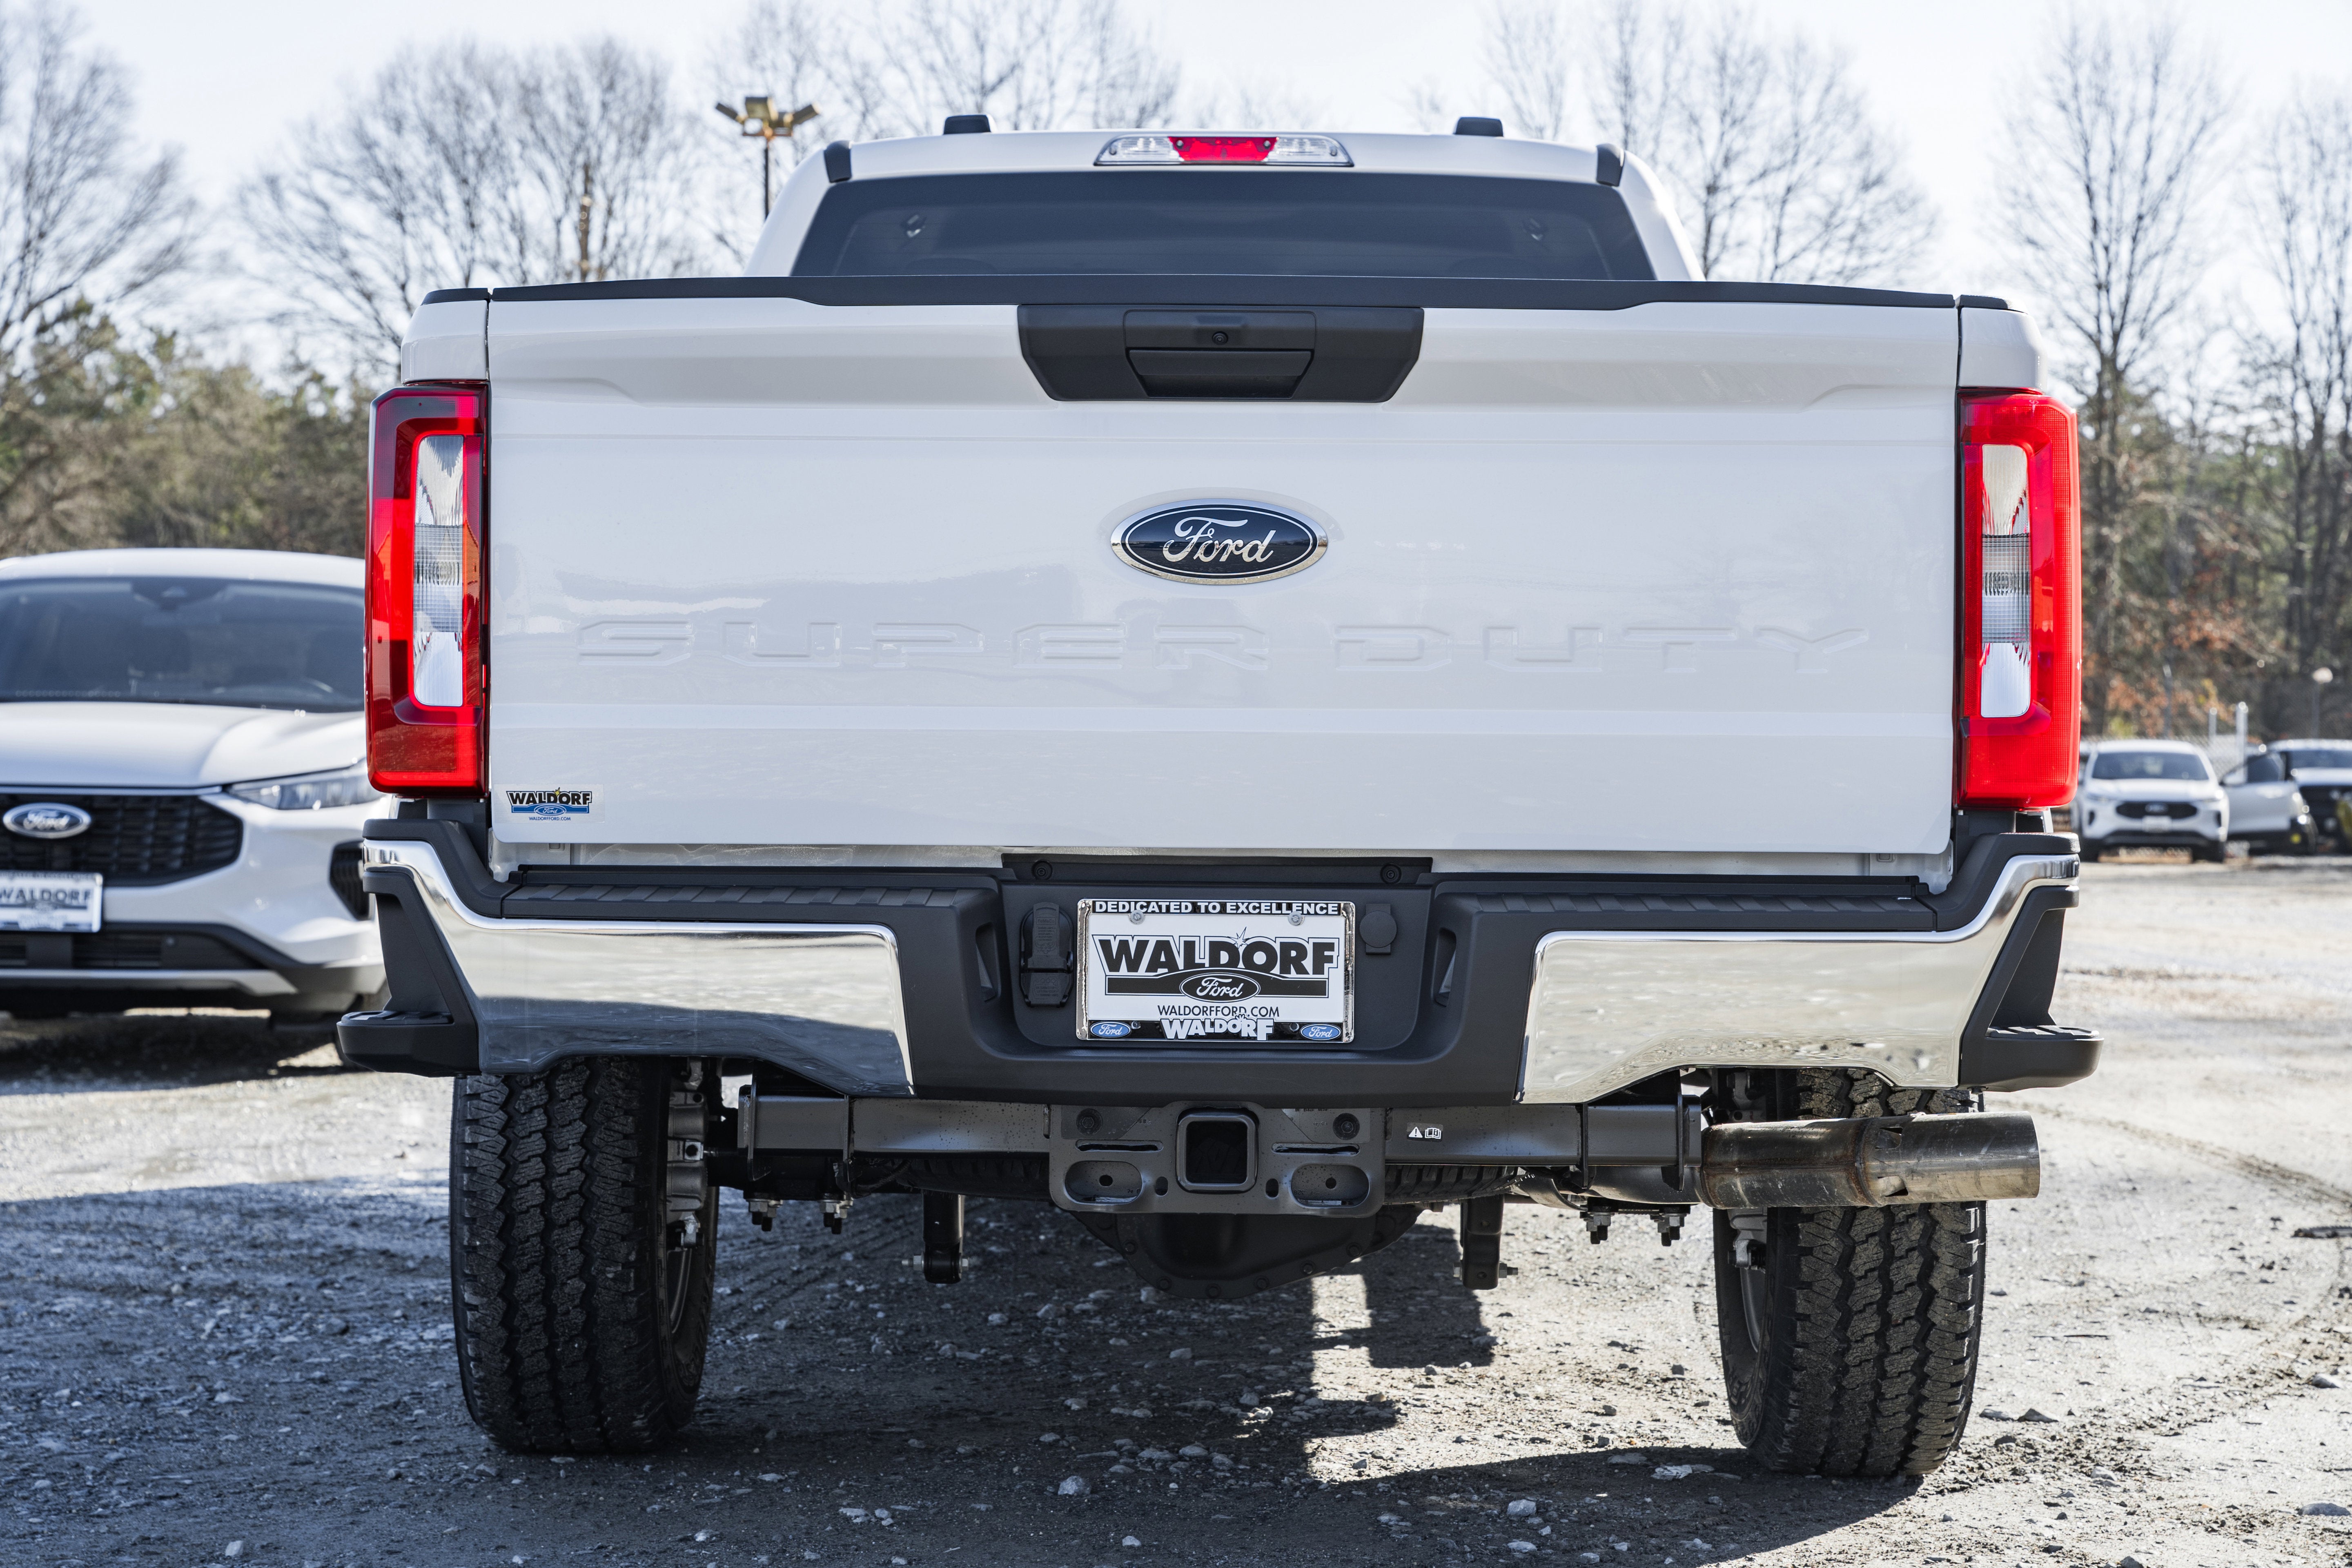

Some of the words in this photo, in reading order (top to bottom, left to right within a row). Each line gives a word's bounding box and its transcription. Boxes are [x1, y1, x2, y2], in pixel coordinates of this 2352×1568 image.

[1163, 517, 1276, 562] Ford
[578, 620, 1269, 670] SUPER
[1335, 626, 1869, 673] DUTY
[509, 793, 590, 805] WALDORF
[1096, 901, 1192, 913] DEDICATED
[1197, 902, 1221, 914] TO
[1226, 902, 1339, 915] EXCELLENCE
[1098, 939, 1337, 976] WALDORF
[1196, 977, 1243, 998] Ford
[1157, 1005, 1280, 1017] WALDORFFORD.COM
[1098, 1024, 1123, 1036] Ford
[1160, 1018, 1274, 1041] WALDORF
[1308, 1025, 1333, 1038] Ford
